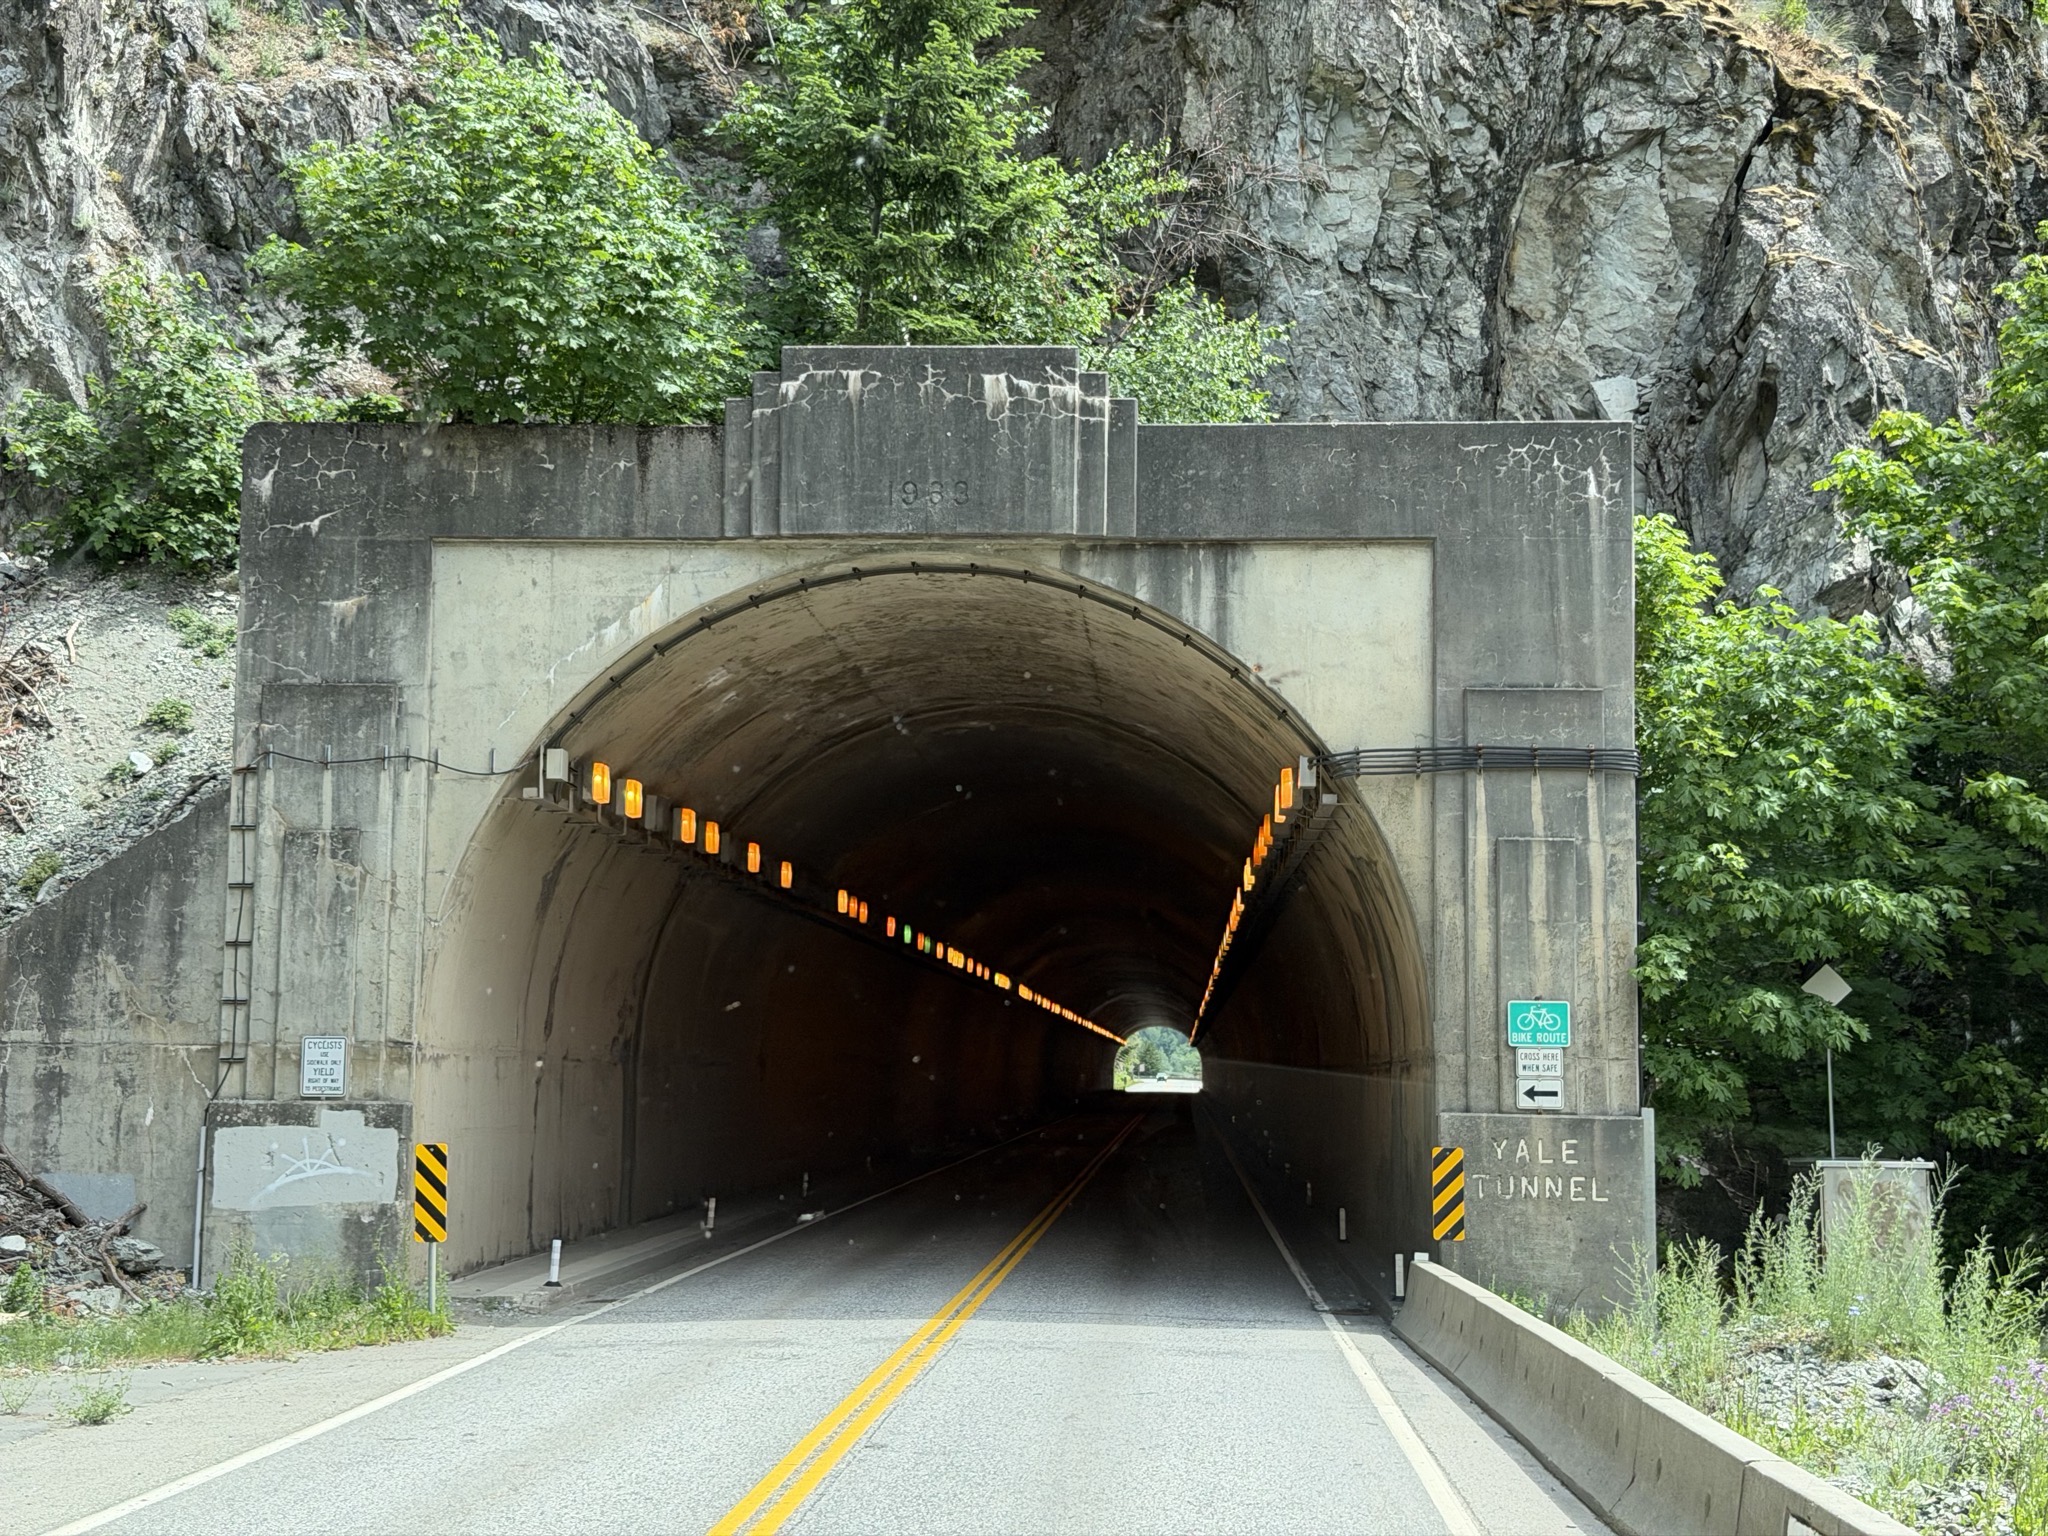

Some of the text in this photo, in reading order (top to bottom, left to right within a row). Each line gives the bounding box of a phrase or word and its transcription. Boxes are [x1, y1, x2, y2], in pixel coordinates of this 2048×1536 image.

[1511, 1032, 1567, 1043] BIKE ROUTE
[307, 1040, 343, 1050] CYCLISTS
[1520, 1052, 1559, 1061] CROSS HERE
[313, 1068, 335, 1076] YIELD
[1522, 1064, 1558, 1073] WHEN SAFE
[1491, 1137, 1579, 1164] YALE
[1472, 1174, 1609, 1202] TUNNEL
